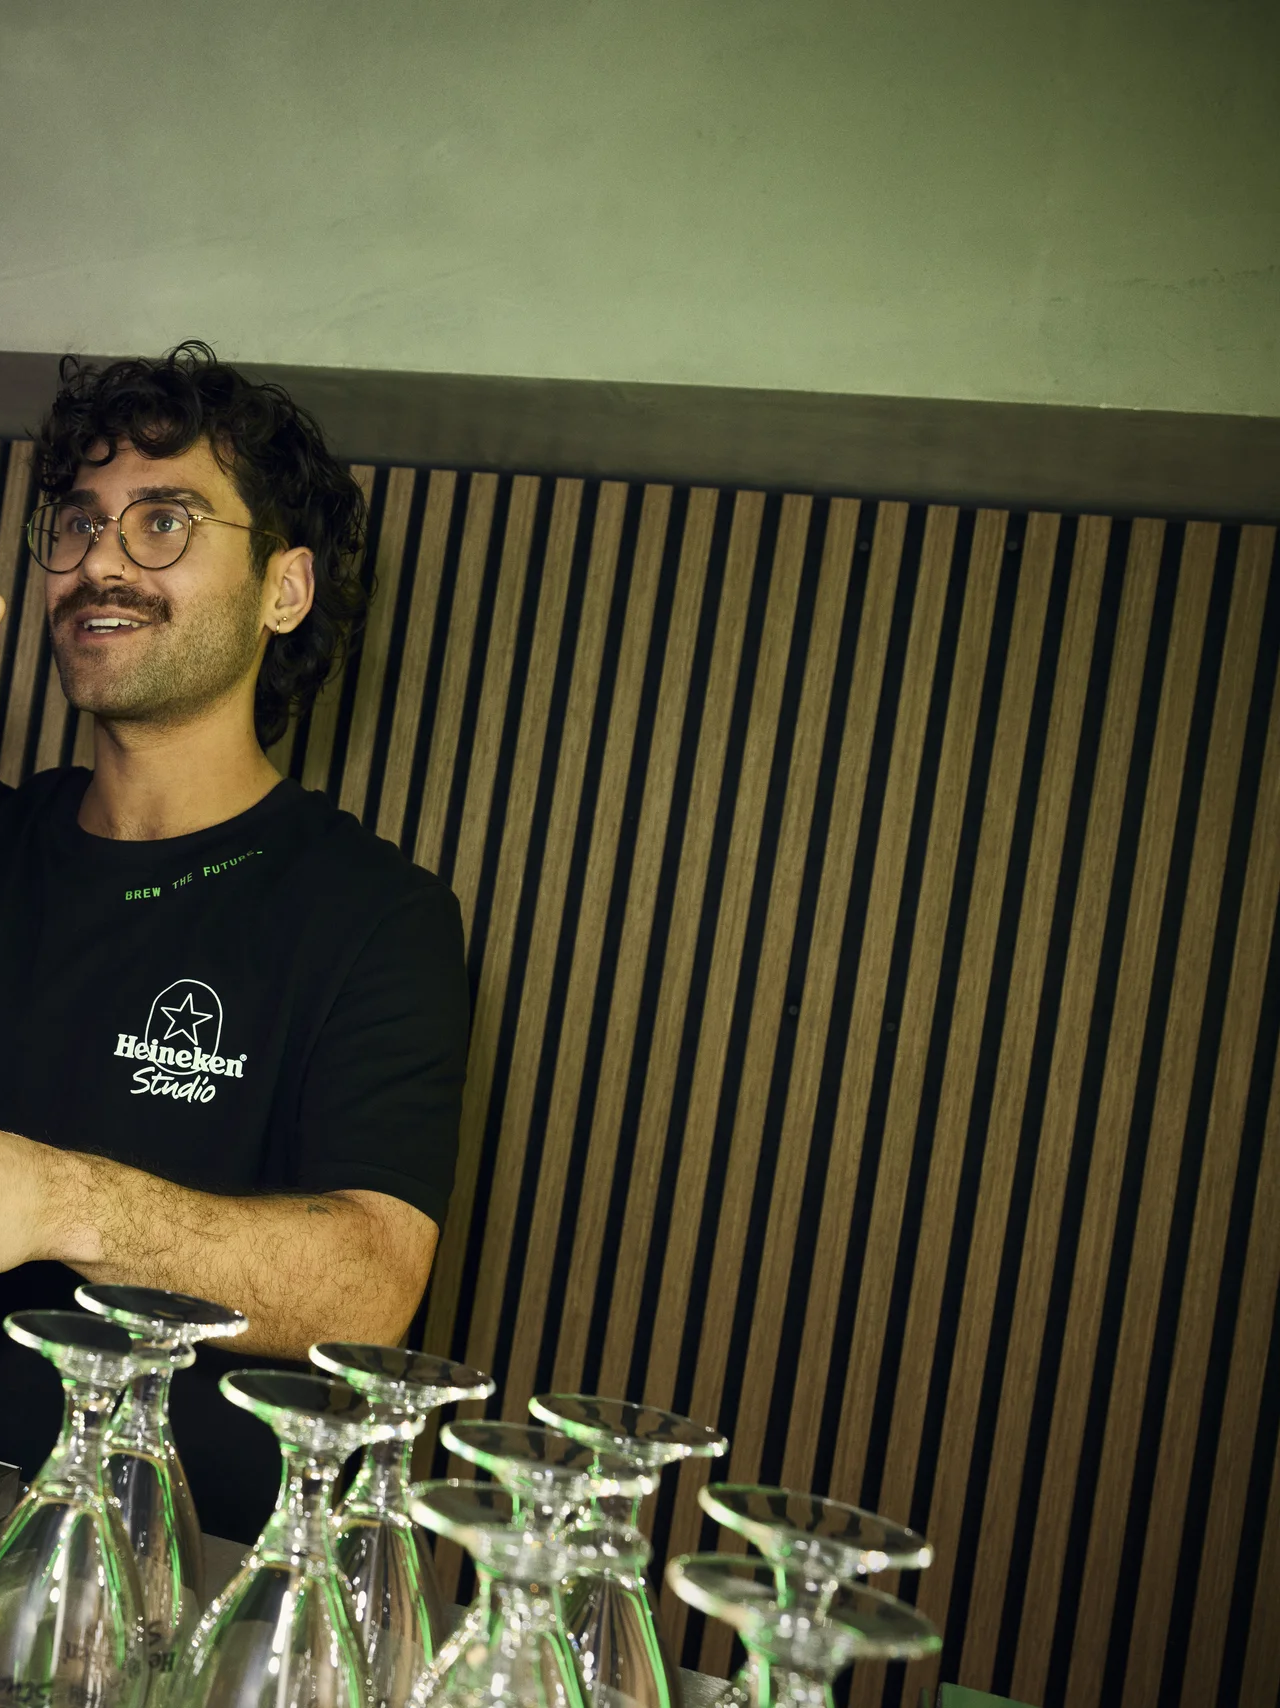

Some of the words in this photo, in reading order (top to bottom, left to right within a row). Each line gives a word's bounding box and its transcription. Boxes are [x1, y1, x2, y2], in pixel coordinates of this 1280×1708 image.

[125, 886, 161, 901] BREW
[172, 872, 193, 890] THE
[113, 1033, 244, 1078] Heineken
[130, 1066, 216, 1103] Studio
